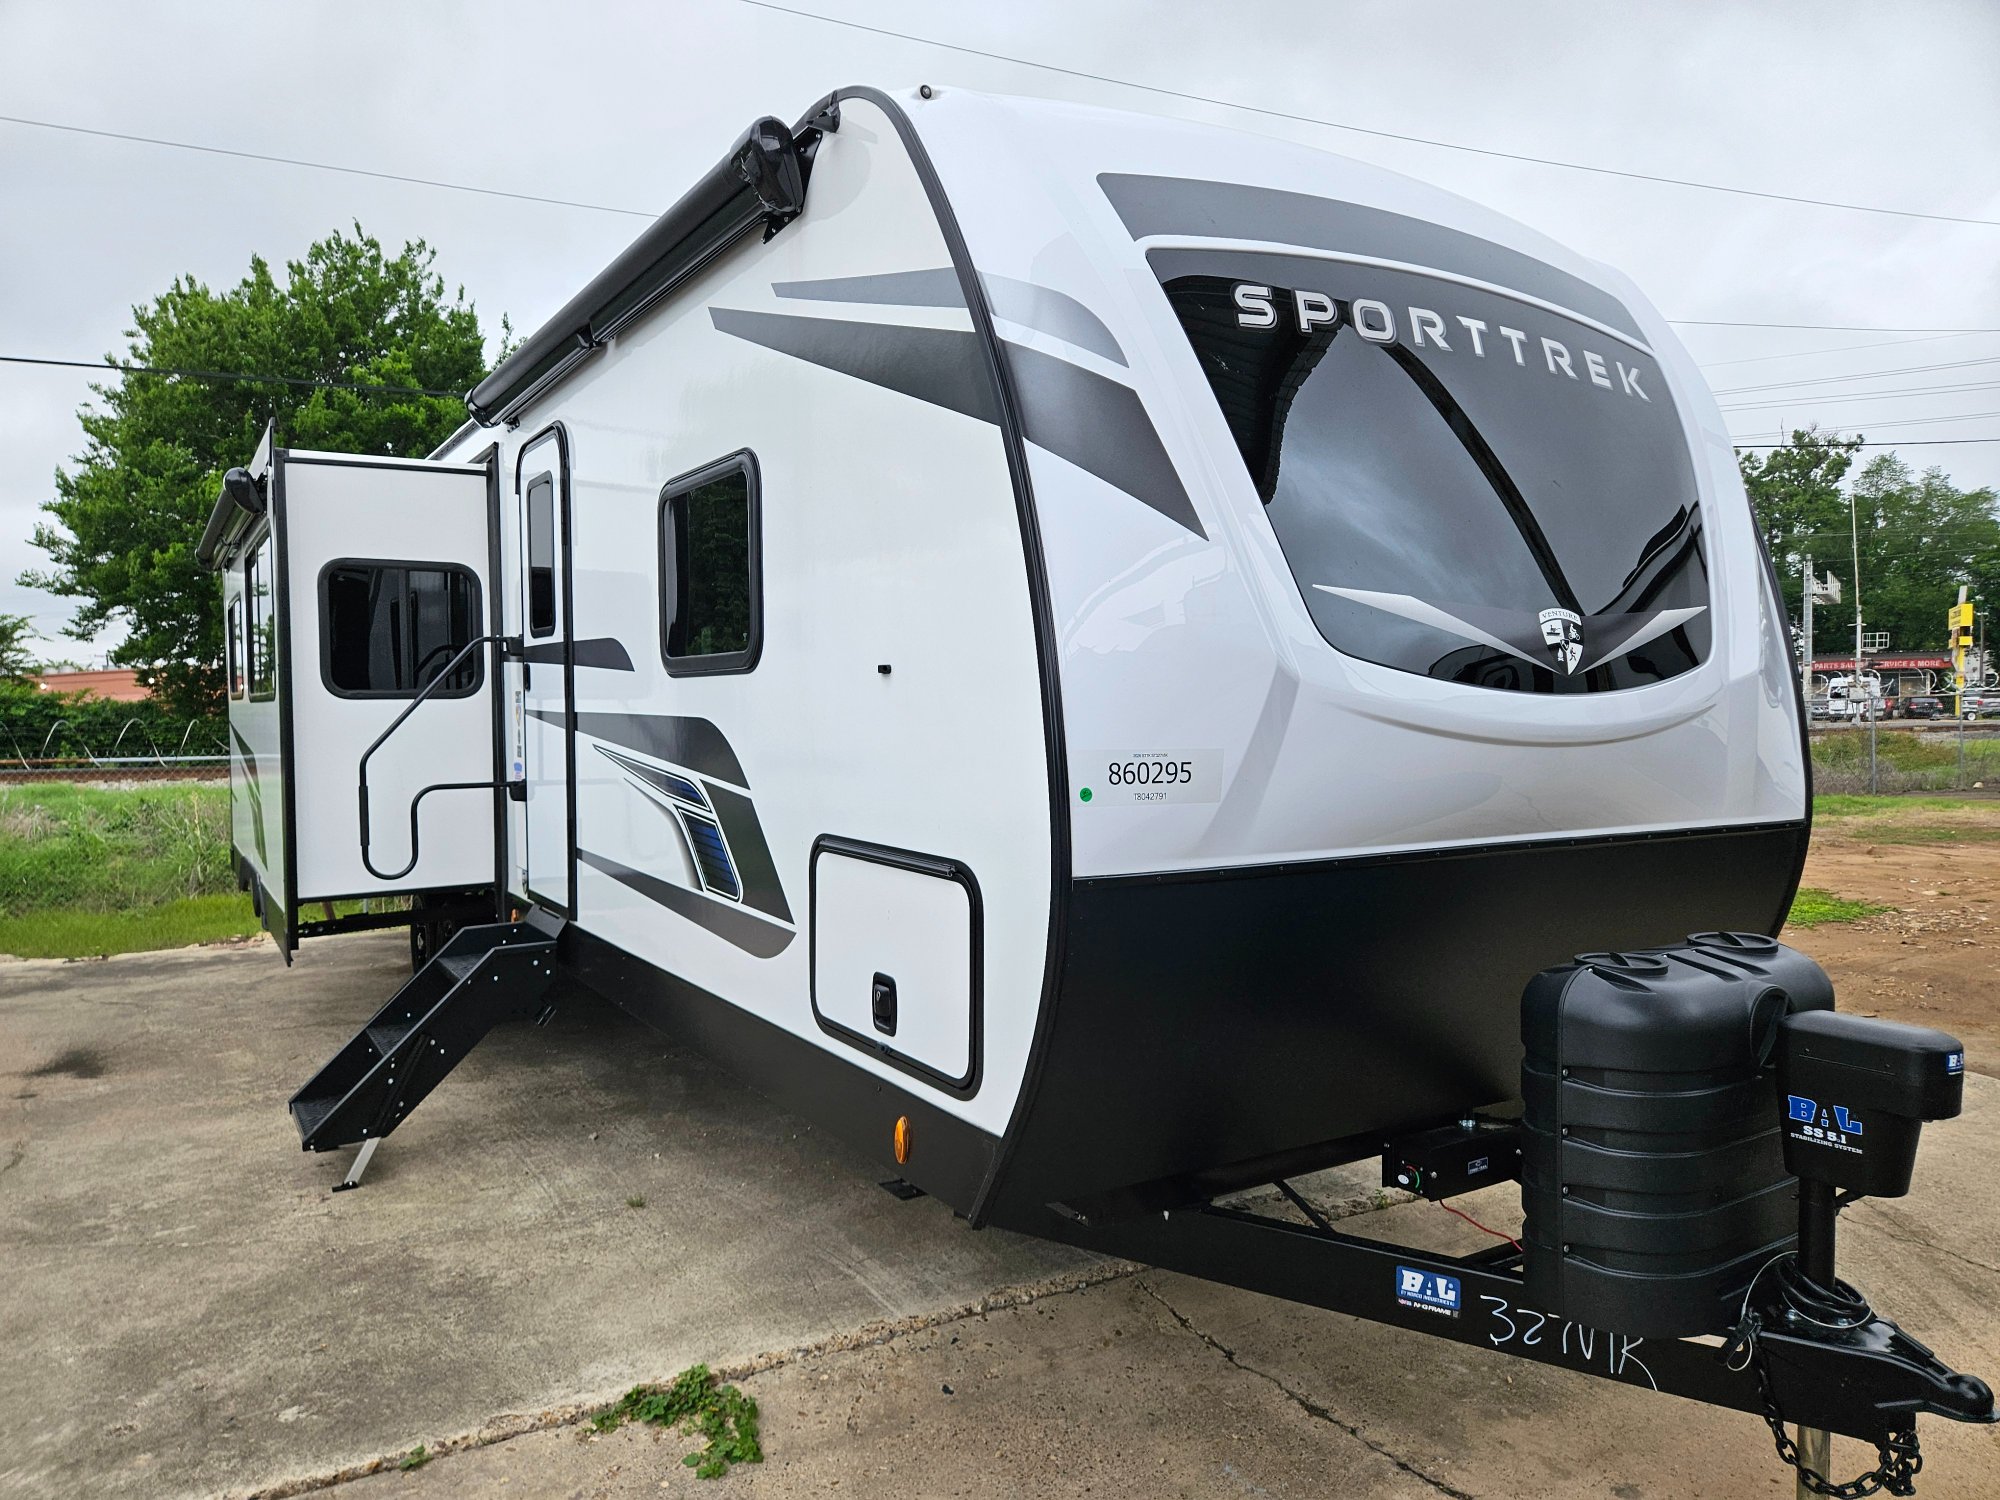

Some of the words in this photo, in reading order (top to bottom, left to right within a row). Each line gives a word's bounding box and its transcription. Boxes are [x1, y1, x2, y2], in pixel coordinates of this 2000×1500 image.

[1232, 283, 1652, 402] SPORTTREK
[1542, 610, 1578, 621] VENTURE
[1815, 662, 1838, 670] PARTS
[1840, 661, 1864, 669] SALS
[1918, 659, 1940, 667] MORE
[1108, 762, 1192, 785] 860295
[1788, 1095, 1863, 1135] BAL
[1790, 1132, 1832, 1147] STABILIZING
[1834, 1143, 1863, 1154] SYSTEM
[1803, 1125, 1823, 1138] SS
[1827, 1131, 1846, 1144] 5.1
[1402, 1269, 1456, 1302] BAL
